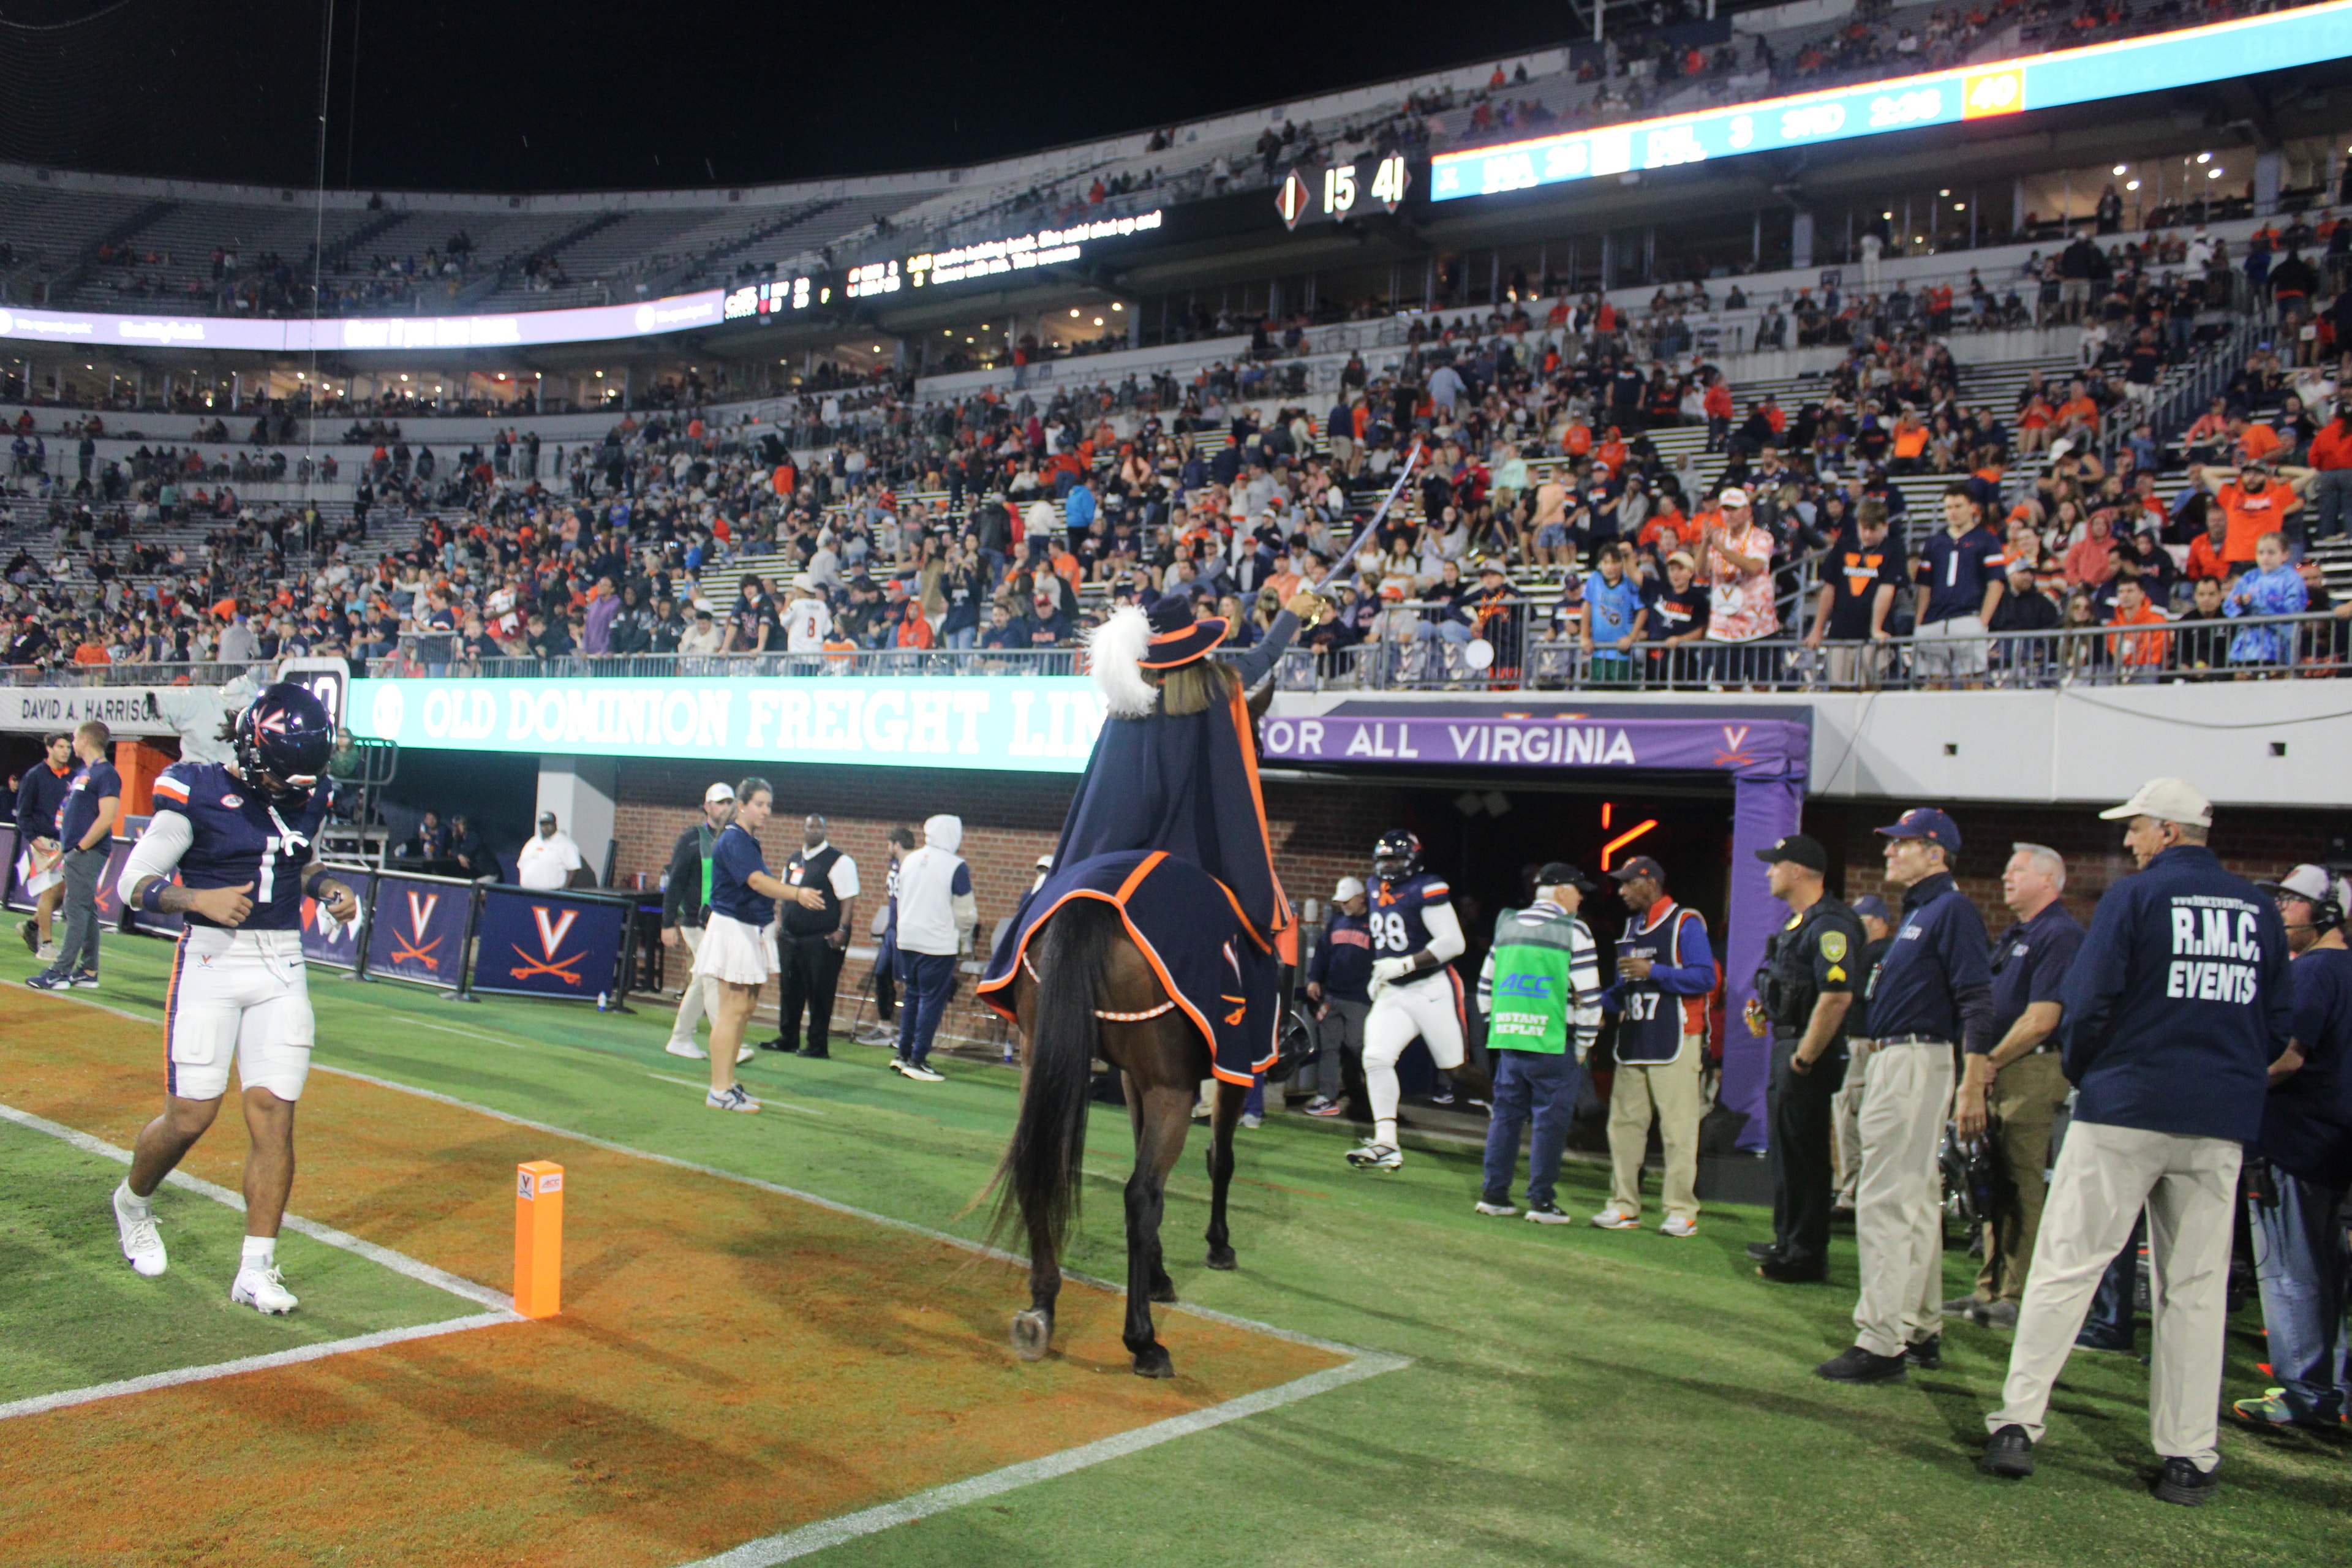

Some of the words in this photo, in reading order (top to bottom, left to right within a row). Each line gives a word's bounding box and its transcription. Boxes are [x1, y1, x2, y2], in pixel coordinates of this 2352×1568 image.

[1969, 74, 2018, 110] 40
[1324, 165, 1356, 214] 15
[1371, 156, 1404, 203] 41
[1946, 550, 1959, 587] 1
[22, 699, 60, 720] DAVID
[66, 699, 79, 720] A.
[85, 699, 161, 722] HARRISO
[423, 688, 497, 739] OLD
[507, 688, 732, 747] DOMINION
[745, 689, 990, 755] FREIGHT
[1008, 690, 1108, 758] LIN
[1345, 723, 1419, 759] ALL
[1447, 725, 1637, 764] VIRGINIA
[258, 836, 280, 903] 1
[2171, 907, 2261, 962] R.M.C.
[1498, 973, 1554, 993] ACC
[2166, 960, 2257, 1005] EVENTS
[1494, 1012, 1550, 1026] INSTANT
[1495, 1023, 1547, 1038] REPLAY
